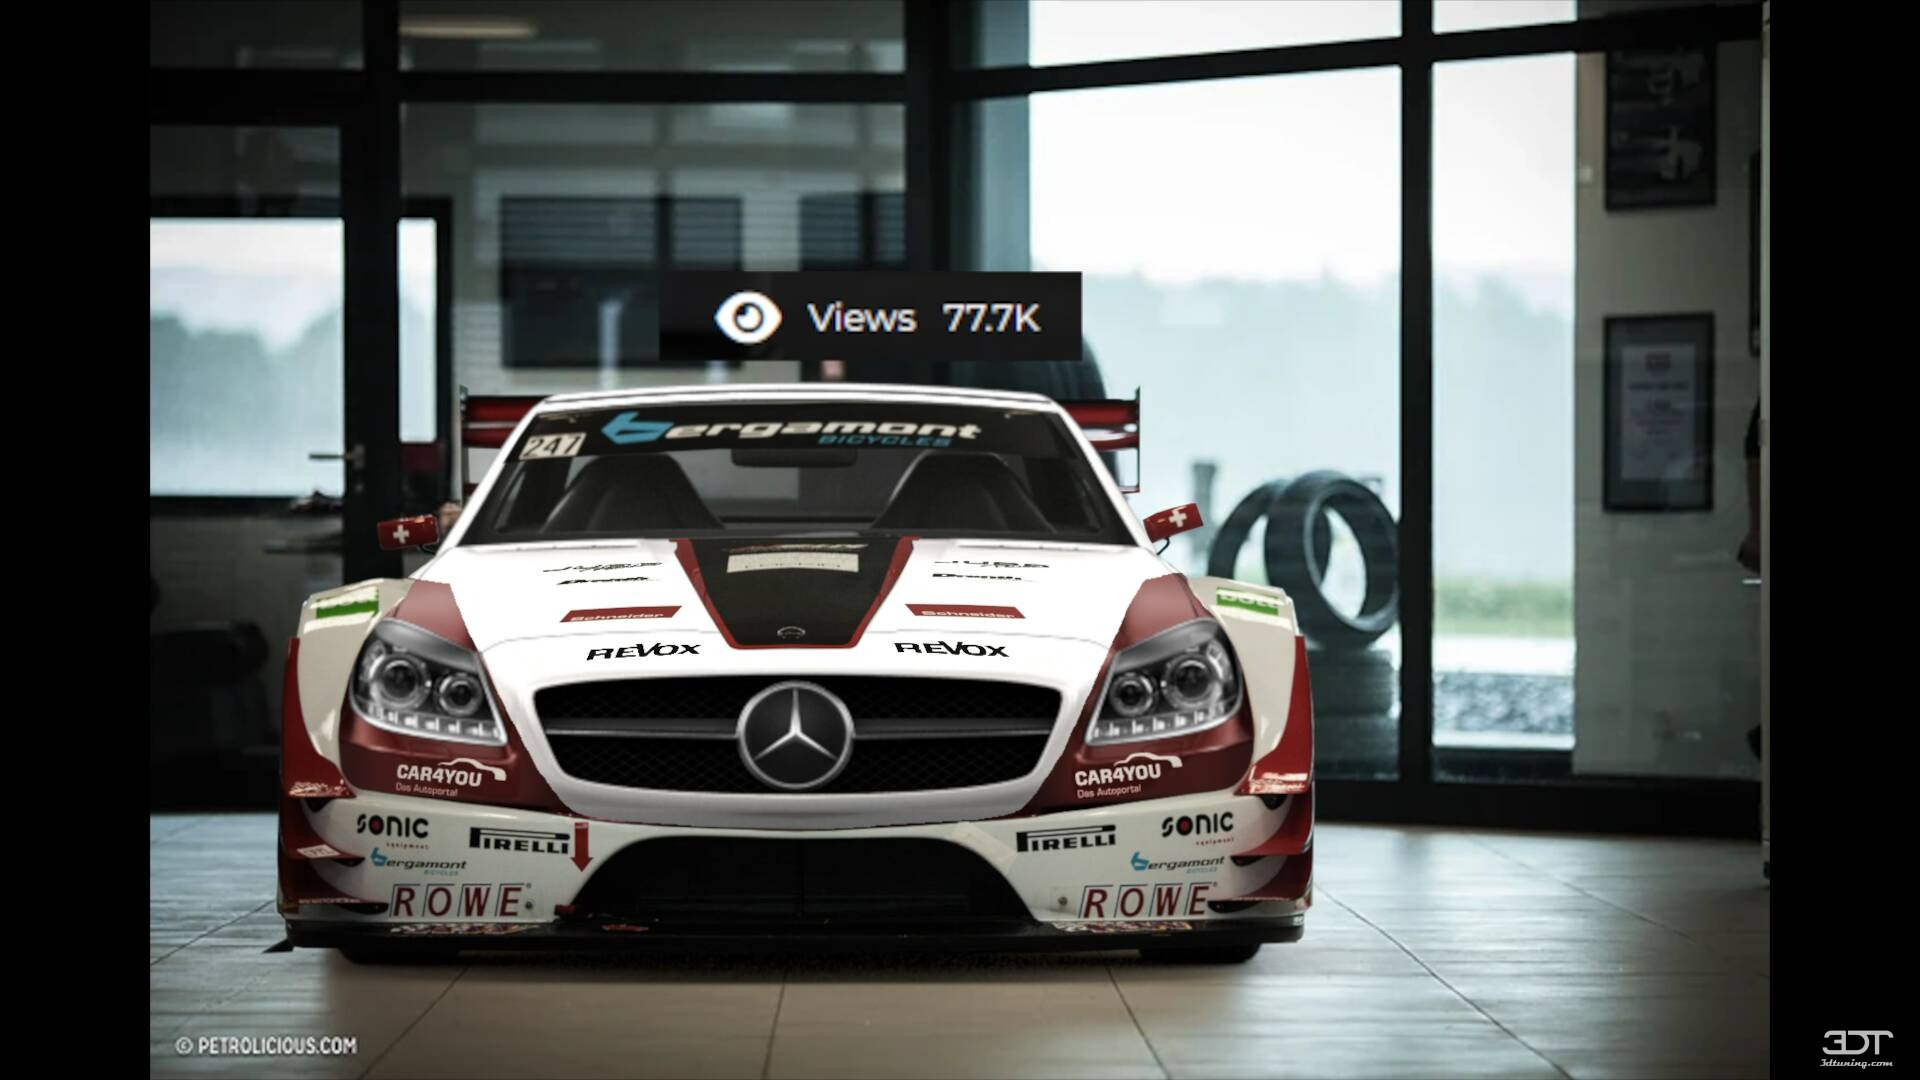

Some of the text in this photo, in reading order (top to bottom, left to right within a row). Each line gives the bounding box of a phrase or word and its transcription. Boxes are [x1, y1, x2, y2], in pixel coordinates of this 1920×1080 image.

[601, 411, 982, 444] bergamont
[522, 434, 582, 458] 247
[818, 434, 951, 447] BICYCLES
[396, 764, 482, 787] CAR4YOU
[1075, 763, 1161, 786] CAR4YOU
[1077, 784, 1141, 799] Das Autoportal
[469, 827, 570, 855] PIRELLI
[1016, 824, 1116, 852] PIRELLI
[371, 847, 467, 870] bergamont
[1130, 851, 1225, 872] bergamont
